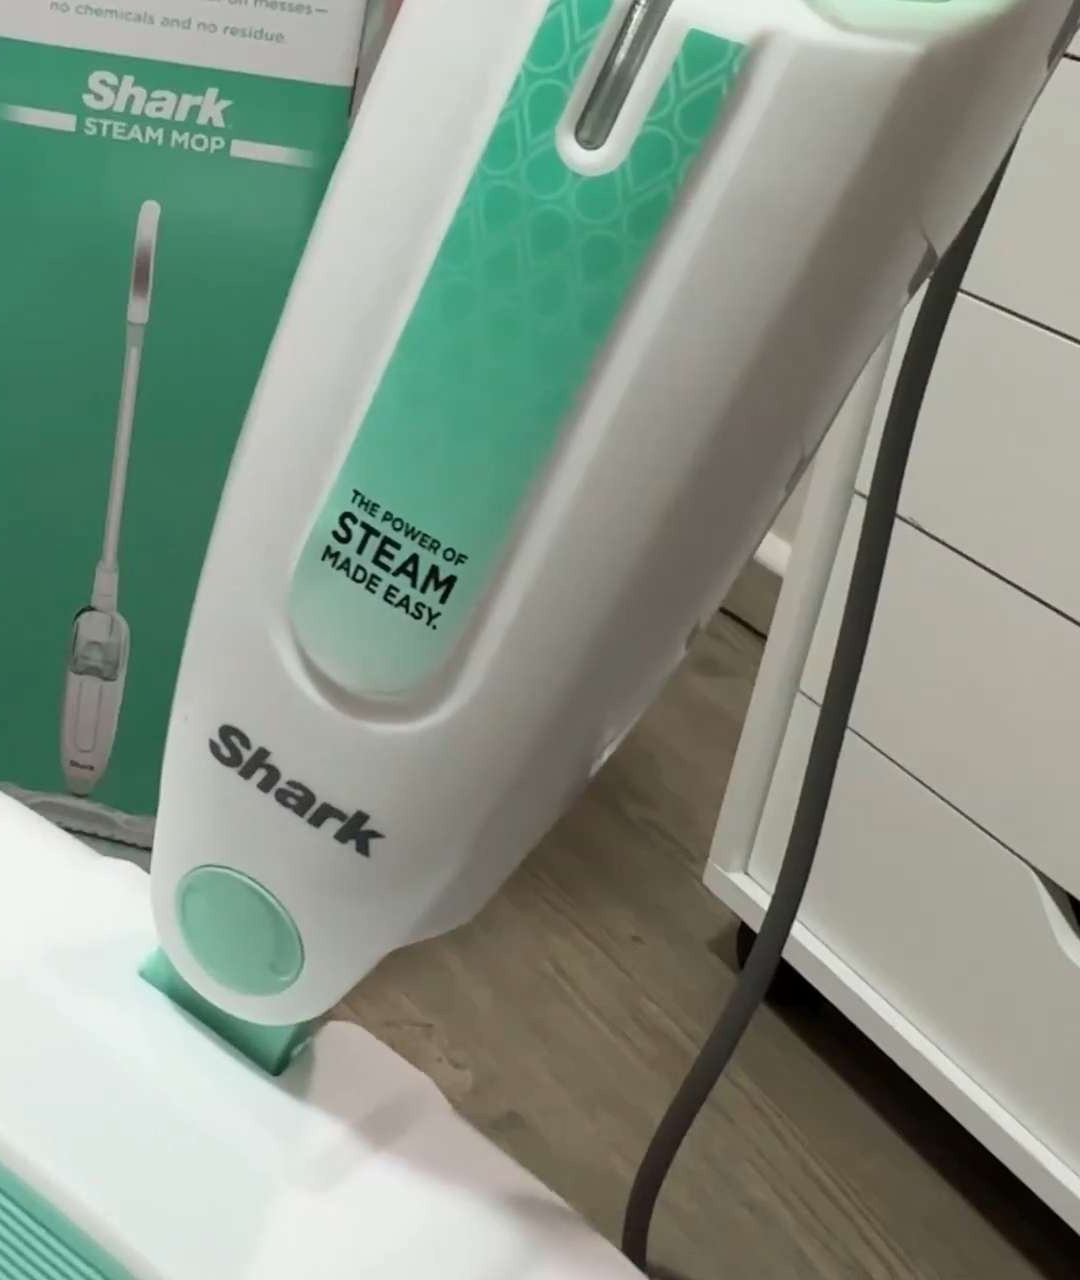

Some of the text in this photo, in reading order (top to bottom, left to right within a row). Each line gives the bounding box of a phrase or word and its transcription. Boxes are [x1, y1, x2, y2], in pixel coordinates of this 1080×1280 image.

[49, 0, 71, 13] no
[74, 2, 155, 25] chemicals
[160, 15, 192, 31] and
[196, 21, 218, 34] no
[81, 70, 233, 128] Shark
[83, 117, 226, 154] STEAM MOP
[331, 510, 458, 605] STEAM
[351, 488, 469, 567] THE POWER OF
[321, 544, 442, 631] MADE EASY.
[209, 724, 387, 858] Shark
